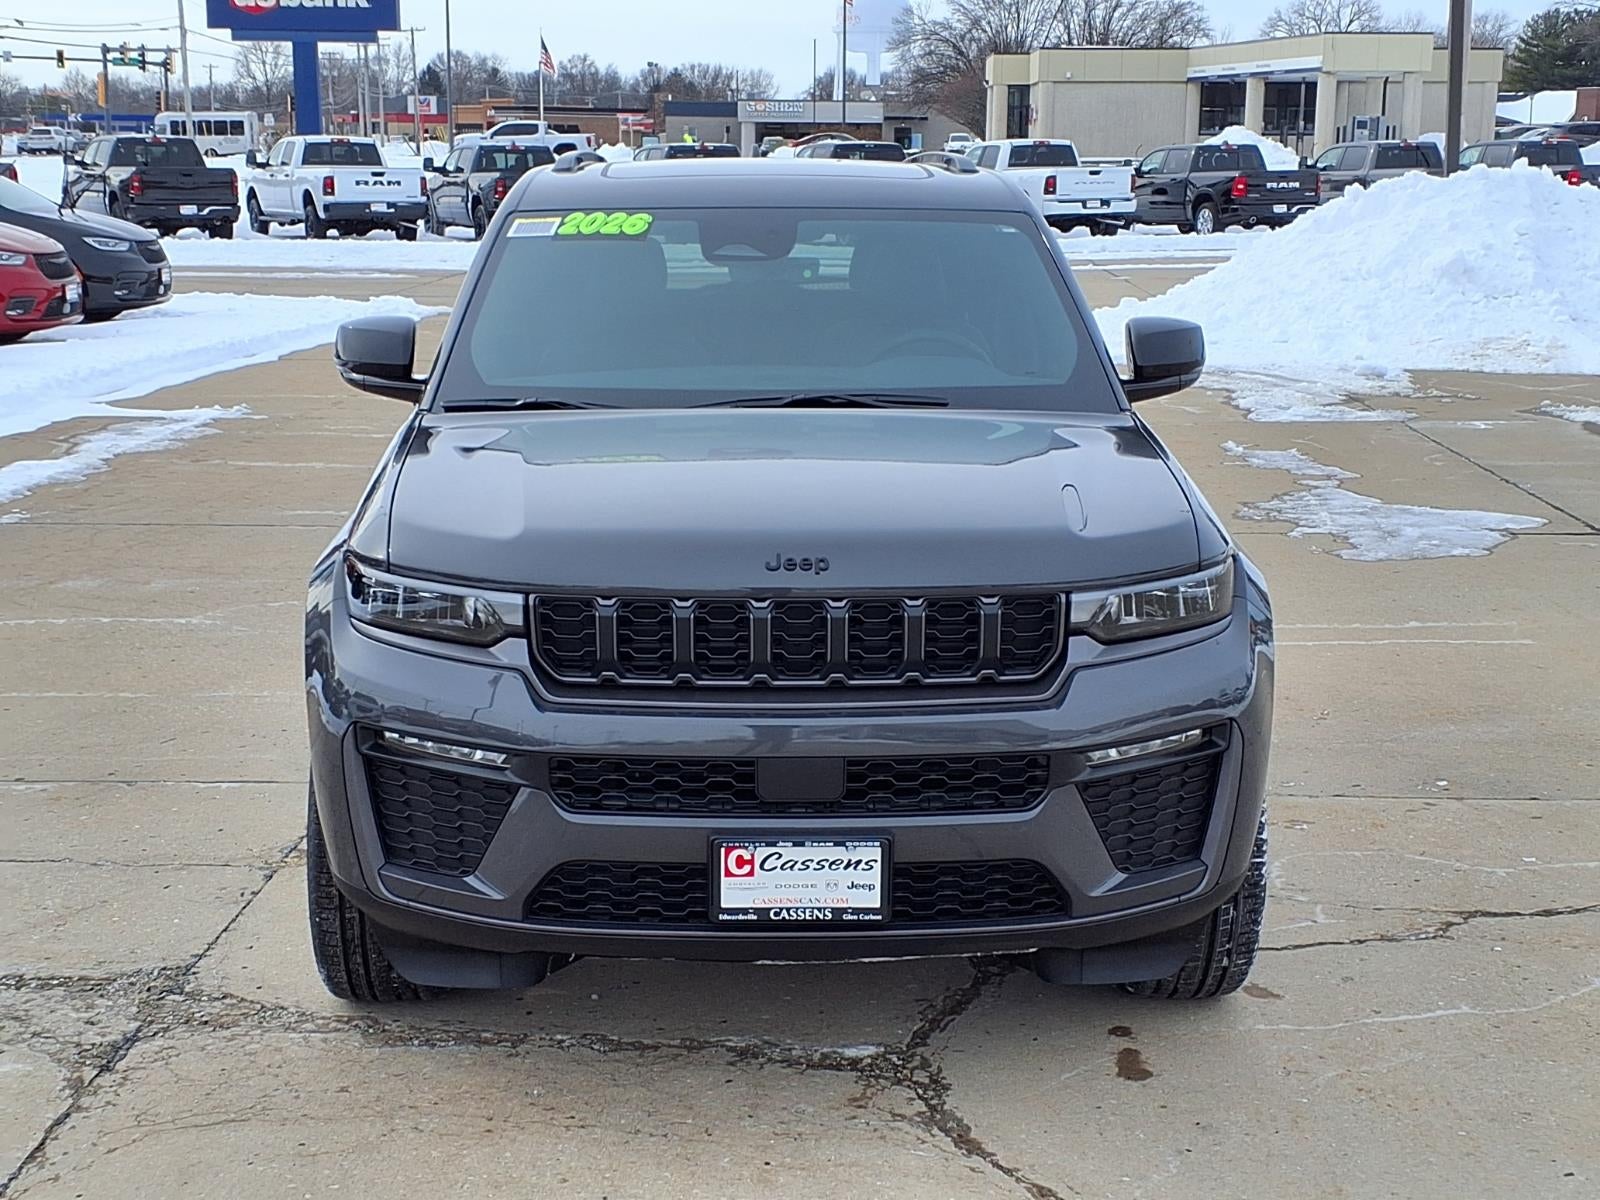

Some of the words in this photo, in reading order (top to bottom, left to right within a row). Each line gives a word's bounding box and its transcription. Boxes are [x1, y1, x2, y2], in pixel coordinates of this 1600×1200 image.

[746, 101, 803, 112] GOSHEN
[556, 211, 652, 235] 2026
[764, 552, 830, 575] Jeep
[727, 849, 752, 875] C
[759, 851, 878, 872] Cassens
[847, 881, 876, 892] Jeep
[752, 897, 849, 905] CASSENSCAN.COM
[769, 908, 833, 920] CASSENS
